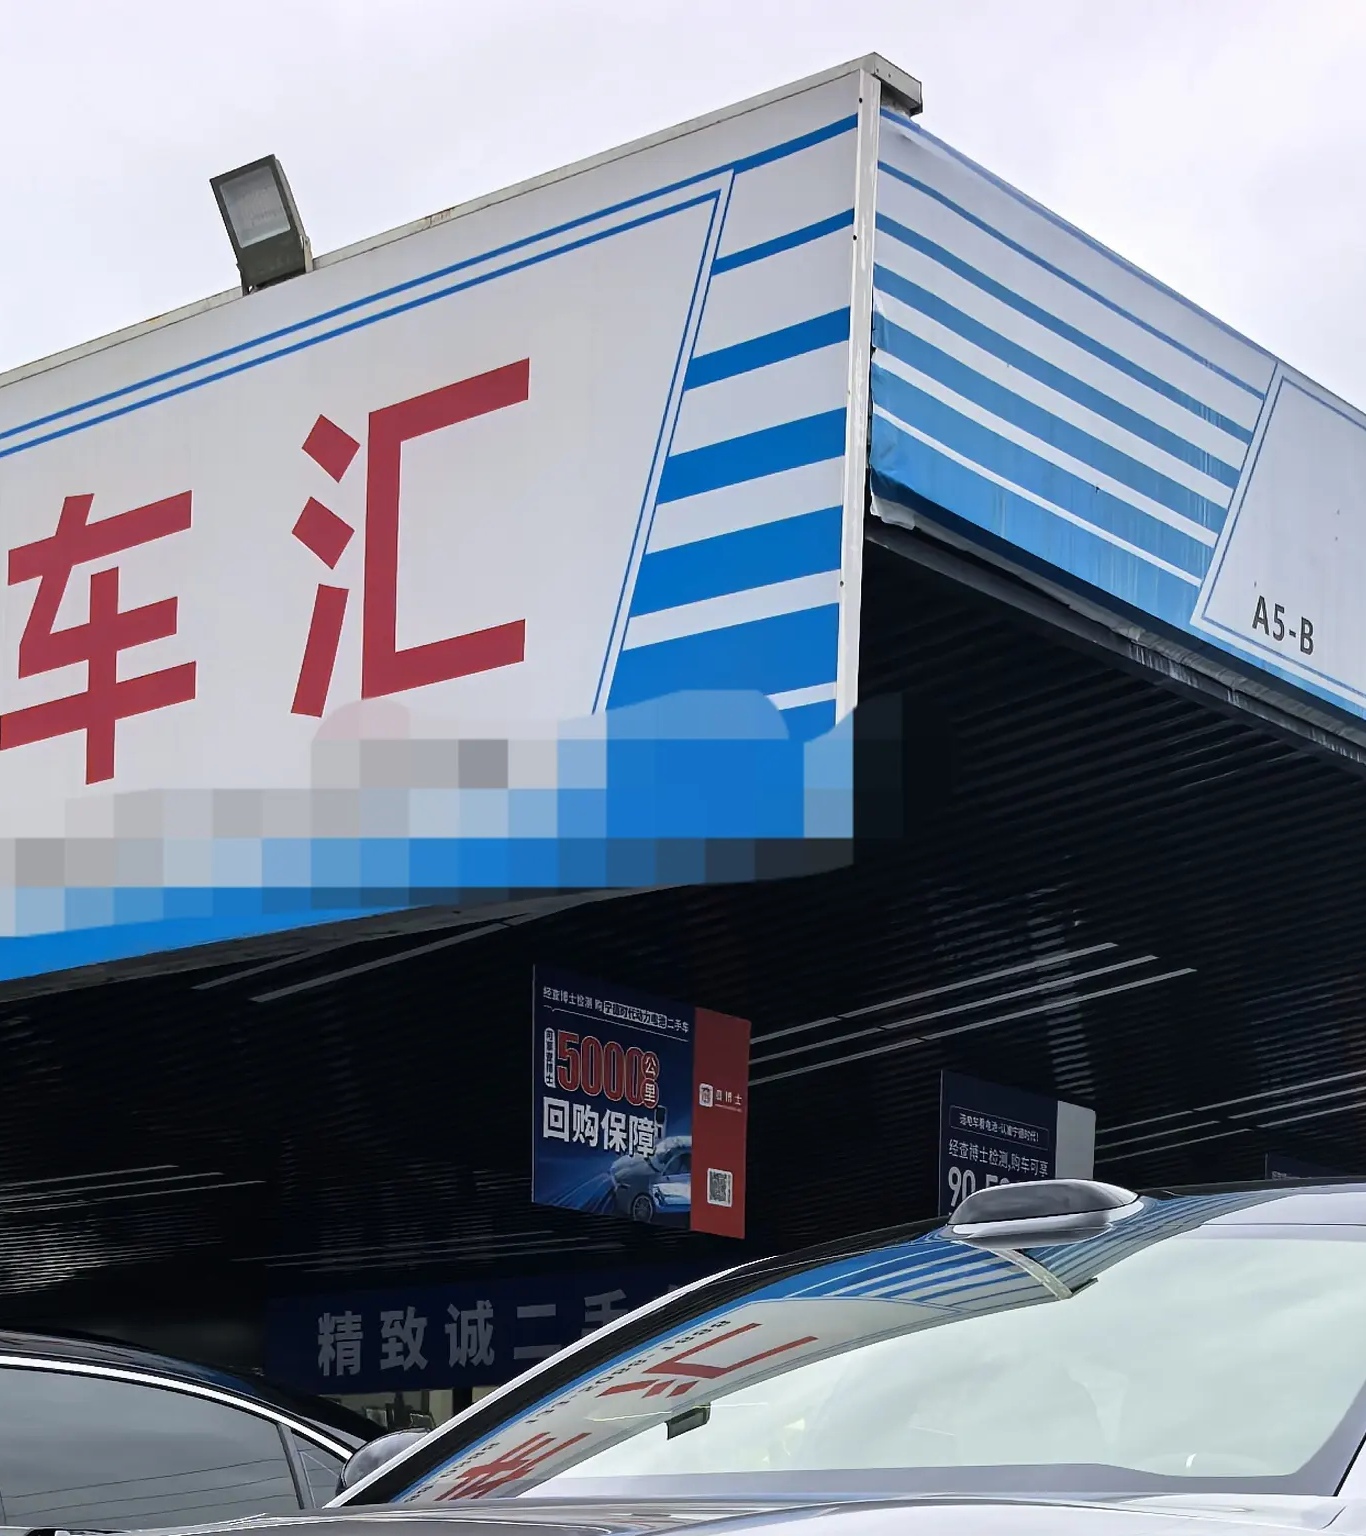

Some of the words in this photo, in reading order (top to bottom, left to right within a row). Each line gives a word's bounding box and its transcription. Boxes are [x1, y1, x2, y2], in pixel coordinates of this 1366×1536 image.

[1251, 595, 1316, 657] A5-B
[542, 1096, 657, 1159] 回购保障
